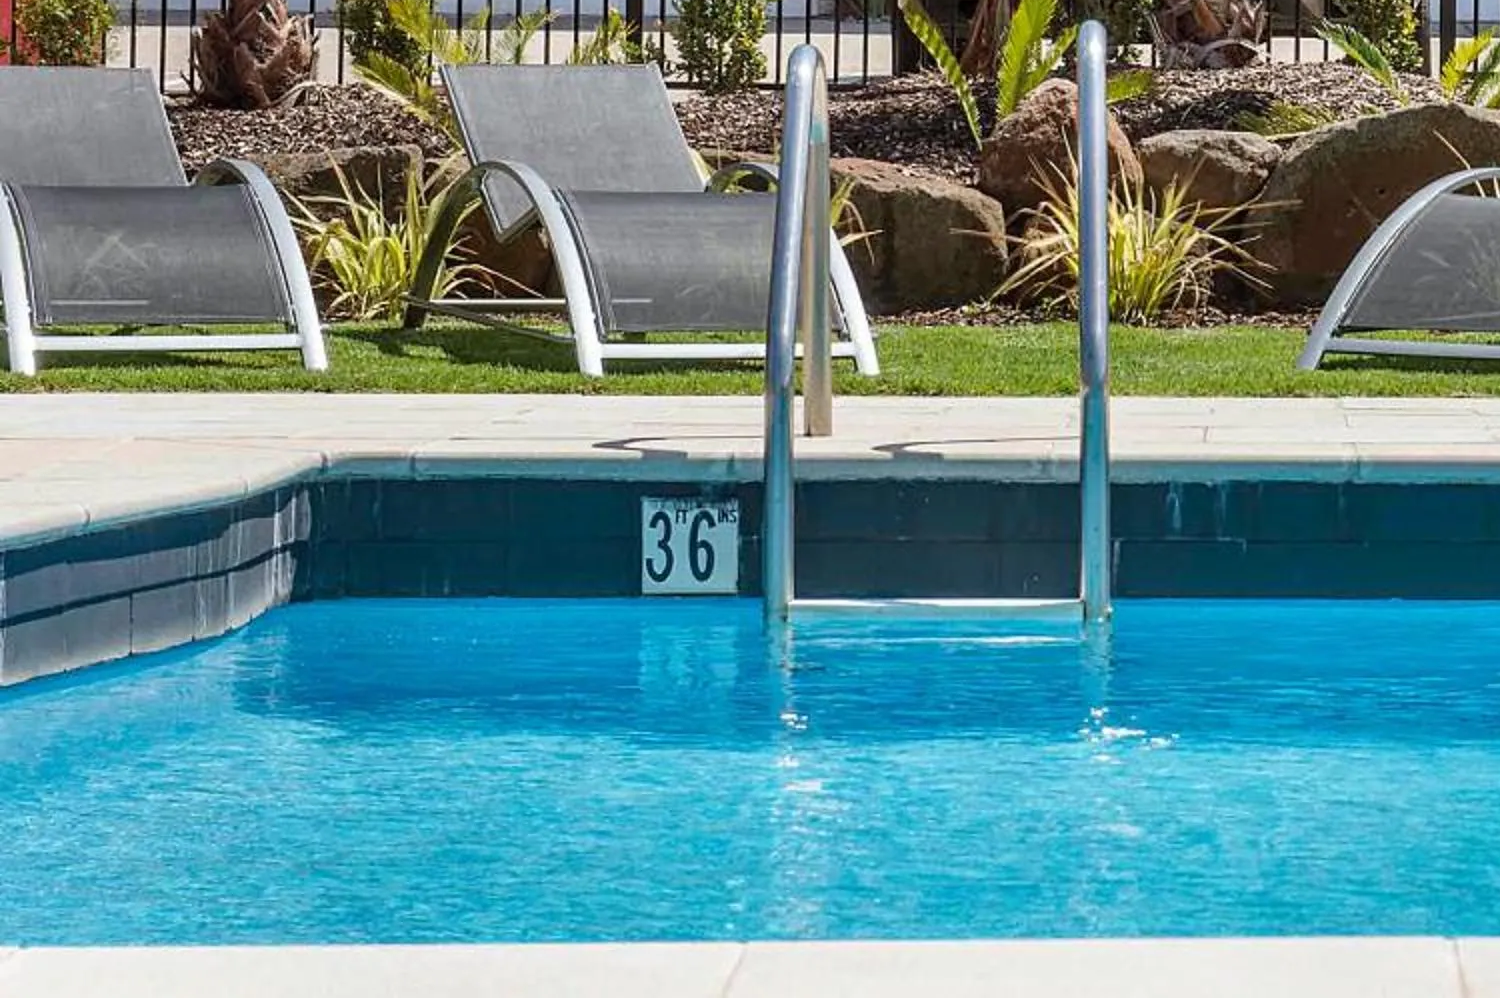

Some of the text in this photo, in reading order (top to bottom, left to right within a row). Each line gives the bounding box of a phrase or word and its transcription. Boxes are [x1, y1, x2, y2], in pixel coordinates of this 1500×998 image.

[646, 509, 737, 583] 3 FT 6 INS
